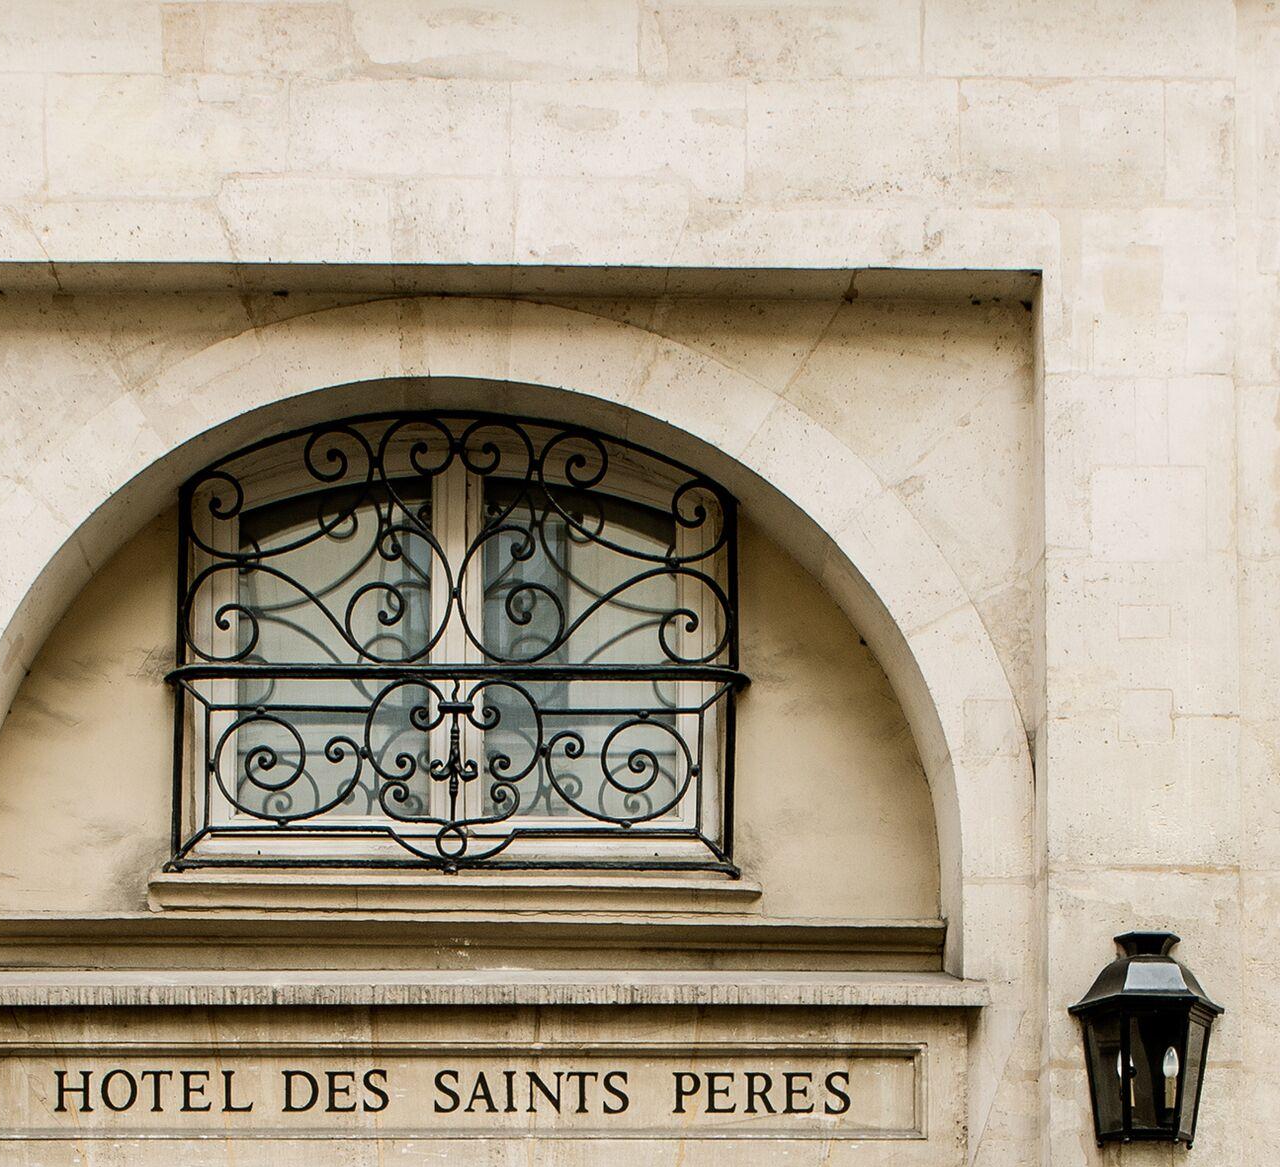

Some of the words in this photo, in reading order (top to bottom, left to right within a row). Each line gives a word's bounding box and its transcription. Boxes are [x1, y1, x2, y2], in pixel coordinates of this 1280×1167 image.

[54, 1069, 254, 1113] HOTEL
[282, 1068, 391, 1113] DES
[434, 1069, 630, 1115] SAINTS
[672, 1070, 852, 1116] PERES
